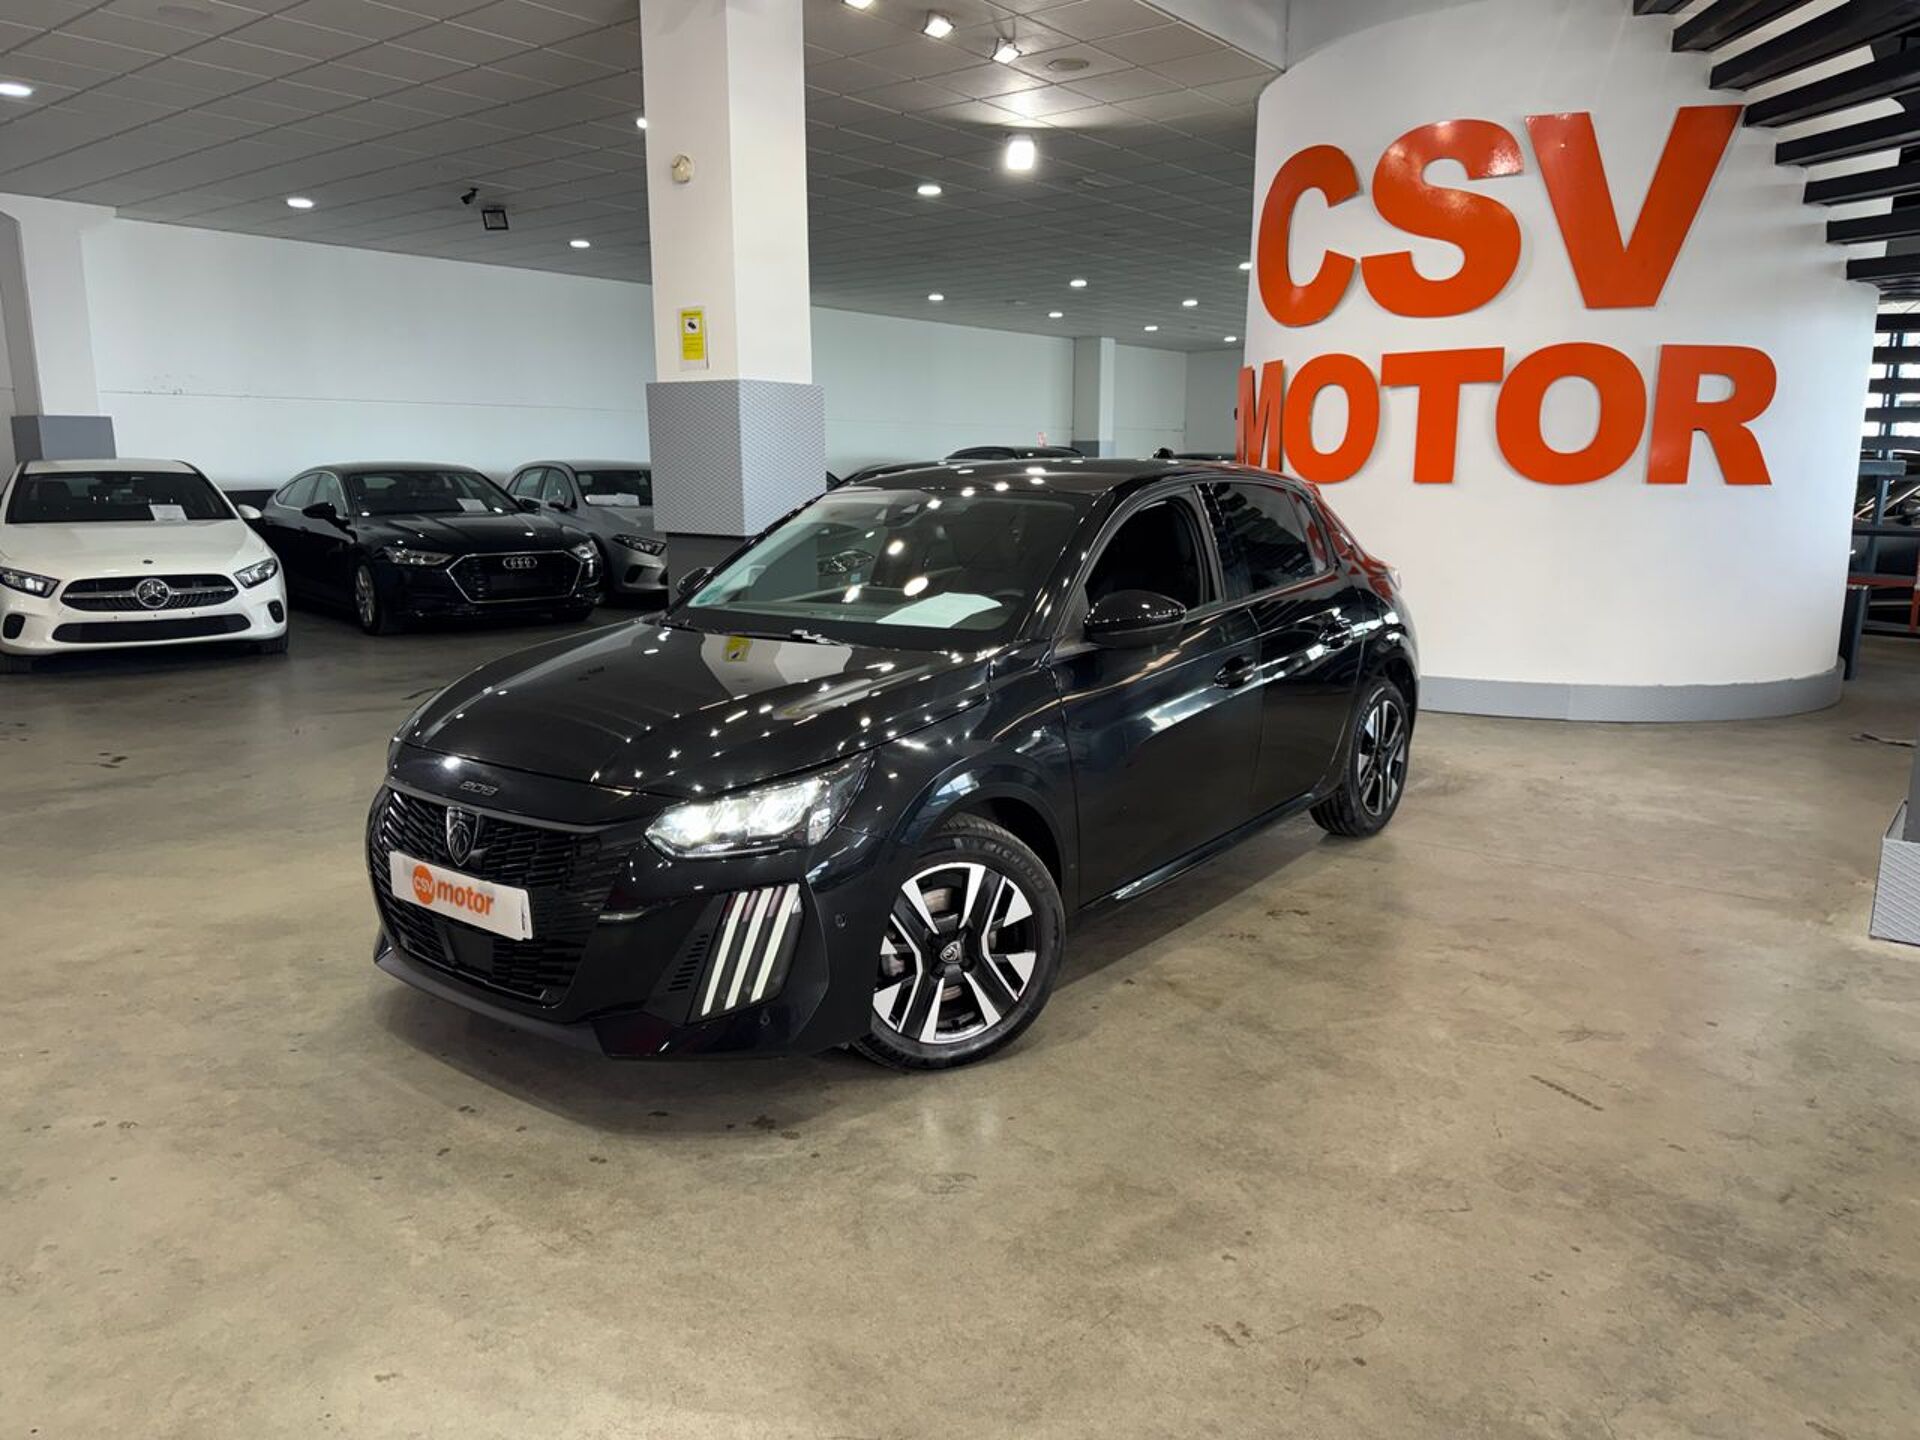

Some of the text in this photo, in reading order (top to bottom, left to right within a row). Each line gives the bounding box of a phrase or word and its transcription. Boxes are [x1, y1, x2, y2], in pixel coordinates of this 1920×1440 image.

[1257, 105, 1745, 327] CSV
[1236, 342, 1777, 486] MOTOR
[437, 881, 495, 915] motor
